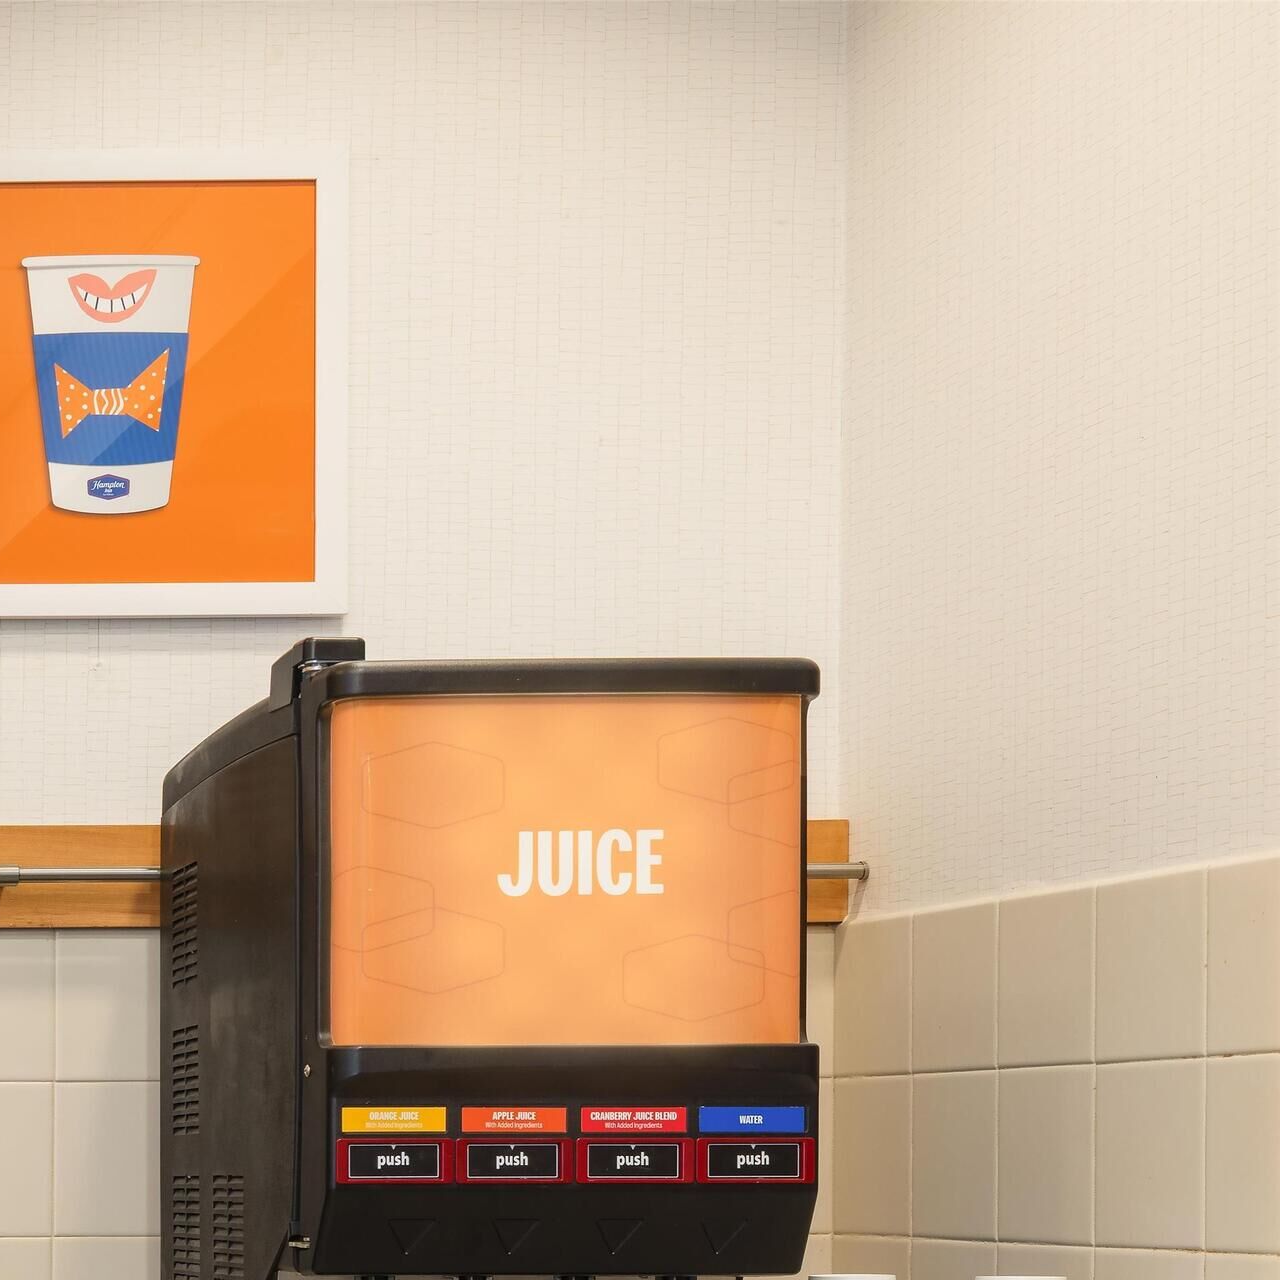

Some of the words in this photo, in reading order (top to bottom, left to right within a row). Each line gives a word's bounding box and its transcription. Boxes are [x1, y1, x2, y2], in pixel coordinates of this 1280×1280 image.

[91, 480, 125, 490] Hampton
[497, 829, 665, 896] JUICE
[369, 1112, 398, 1120] ORANGE
[399, 1112, 420, 1120] JUICE
[492, 1112, 514, 1120] APPLE
[515, 1112, 536, 1120] JUICE
[590, 1112, 632, 1120] CRANBERRY
[633, 1112, 654, 1120] JUICE
[655, 1112, 678, 1120] BLEND
[739, 1115, 763, 1124] WATER
[514, 1122, 543, 1130] Ingredients
[634, 1122, 663, 1130] Ingredients
[377, 1152, 410, 1169] push
[496, 1152, 528, 1169] push
[616, 1152, 649, 1169] push
[736, 1151, 770, 1168] push
